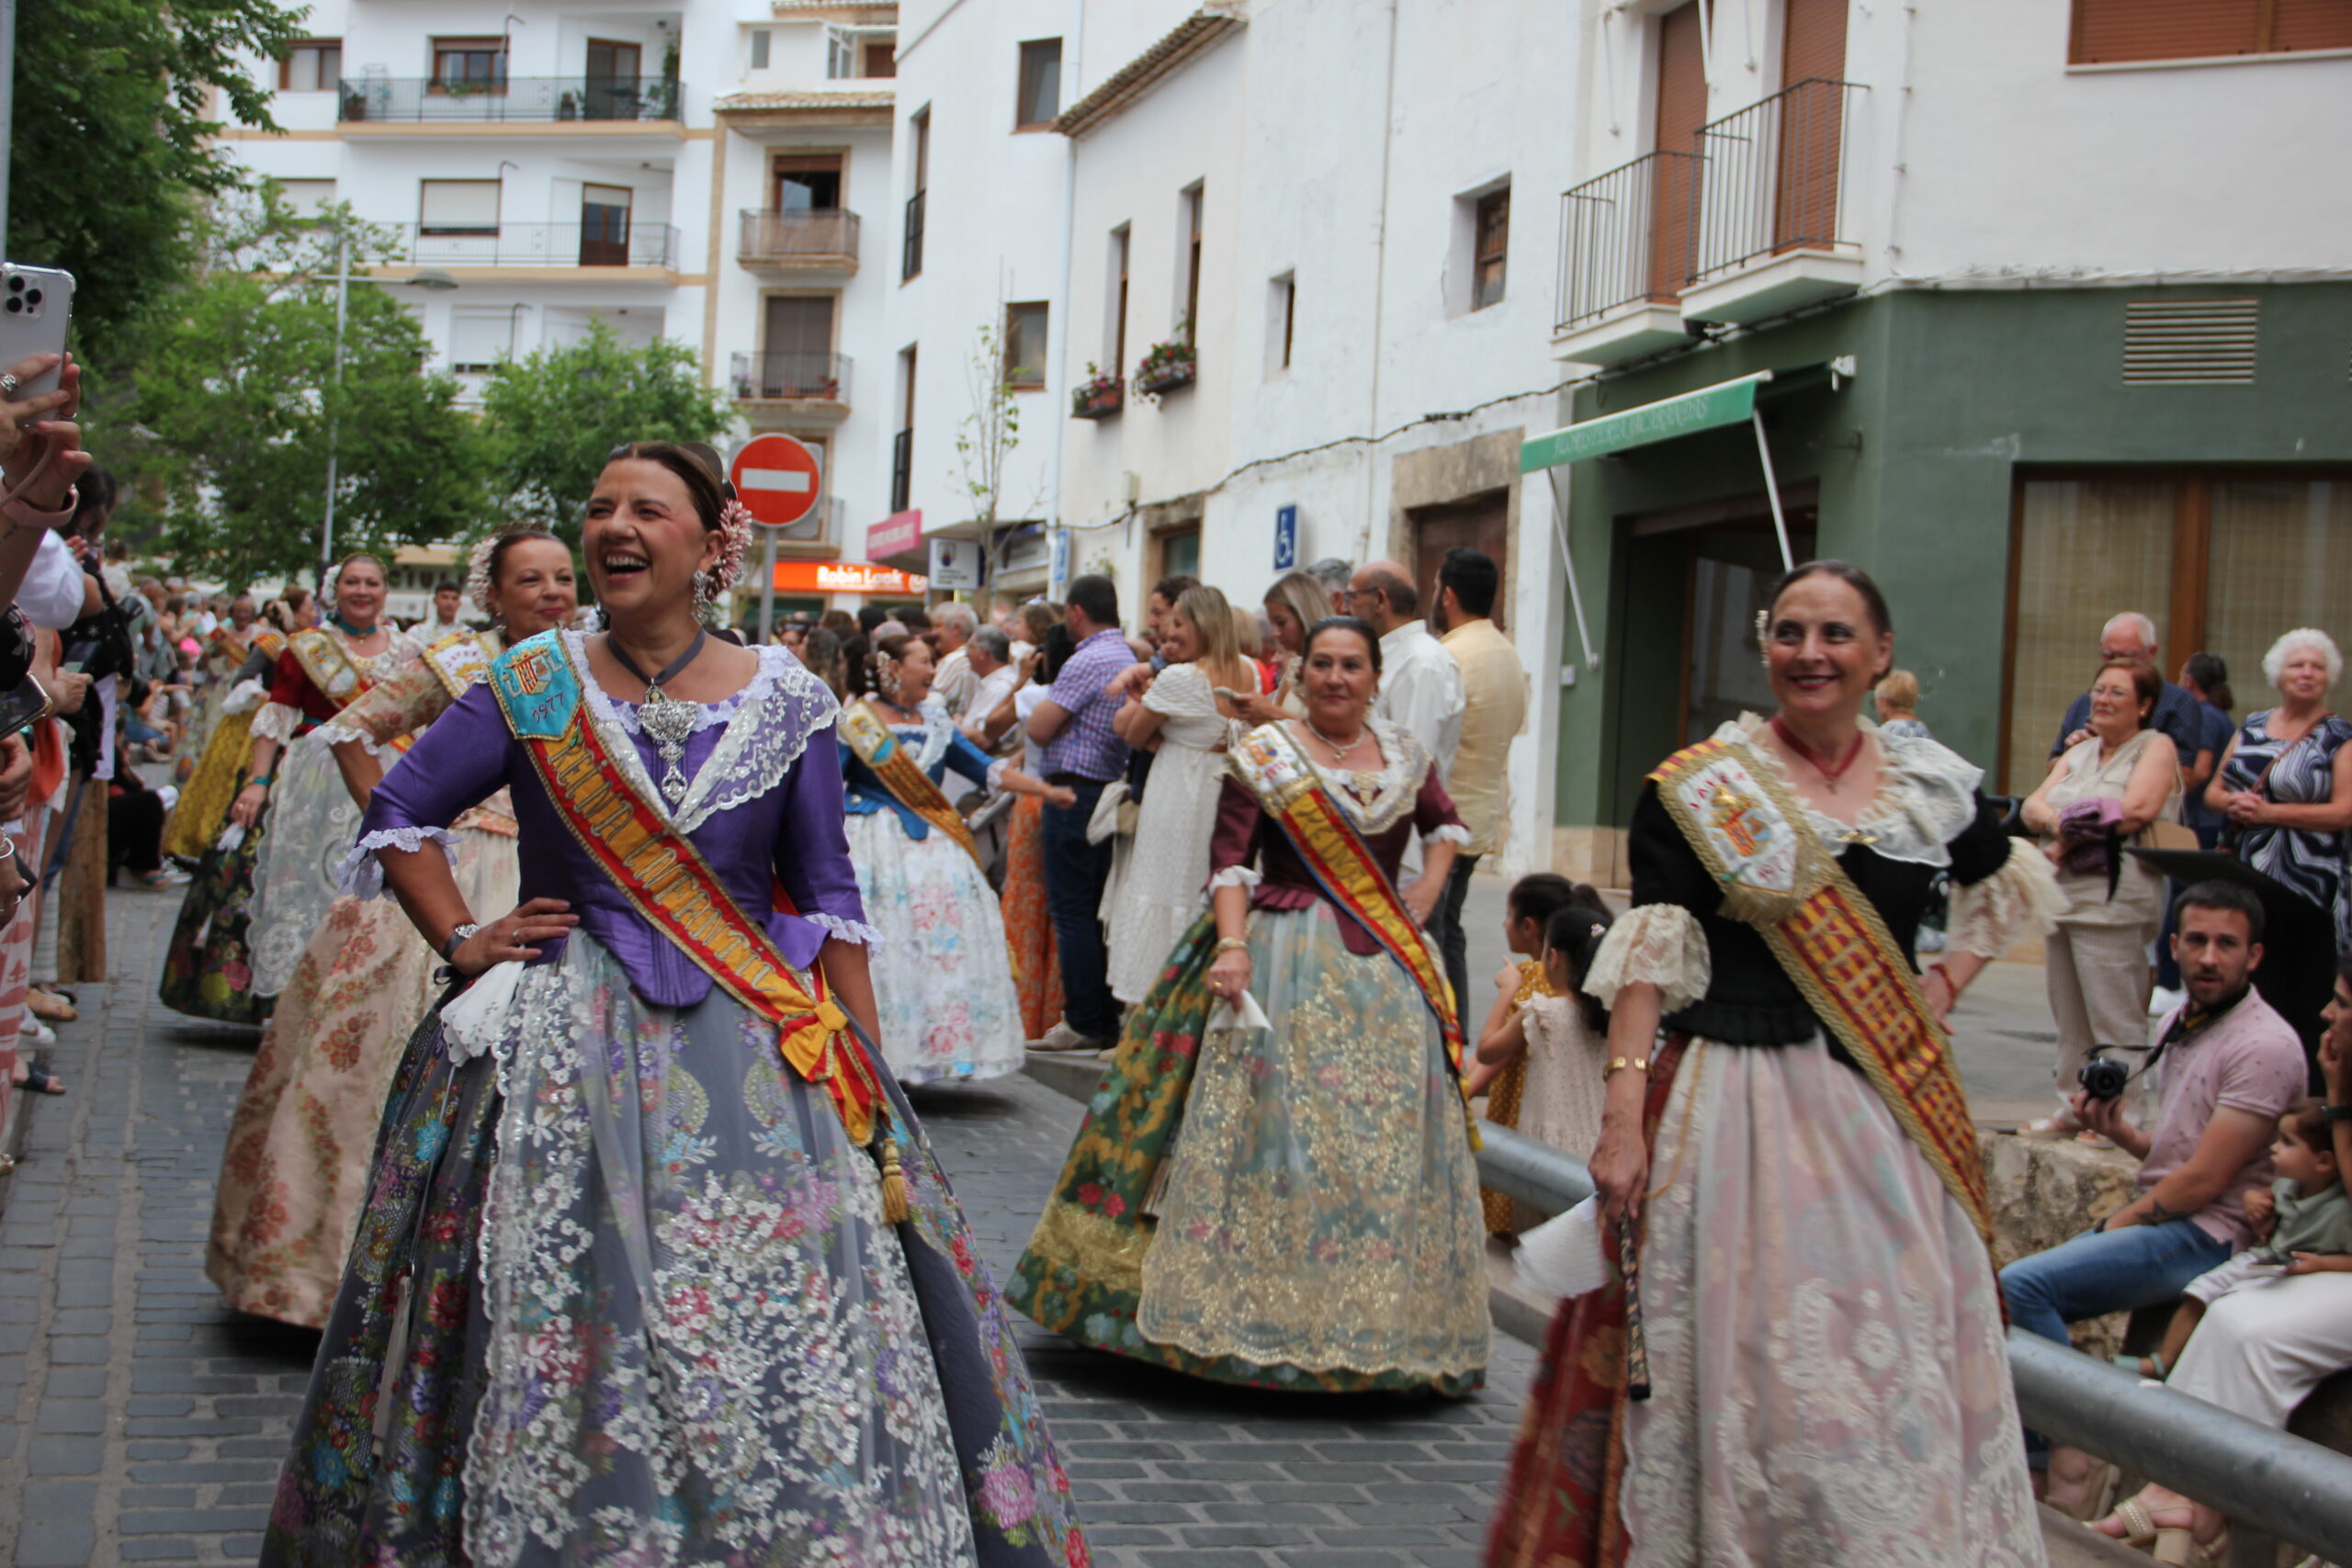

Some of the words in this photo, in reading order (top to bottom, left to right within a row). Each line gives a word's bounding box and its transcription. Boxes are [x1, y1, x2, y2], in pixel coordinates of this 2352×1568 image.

[817, 564, 862, 583] Robin
[864, 568, 903, 585] Look
[532, 691, 565, 725] 1977
